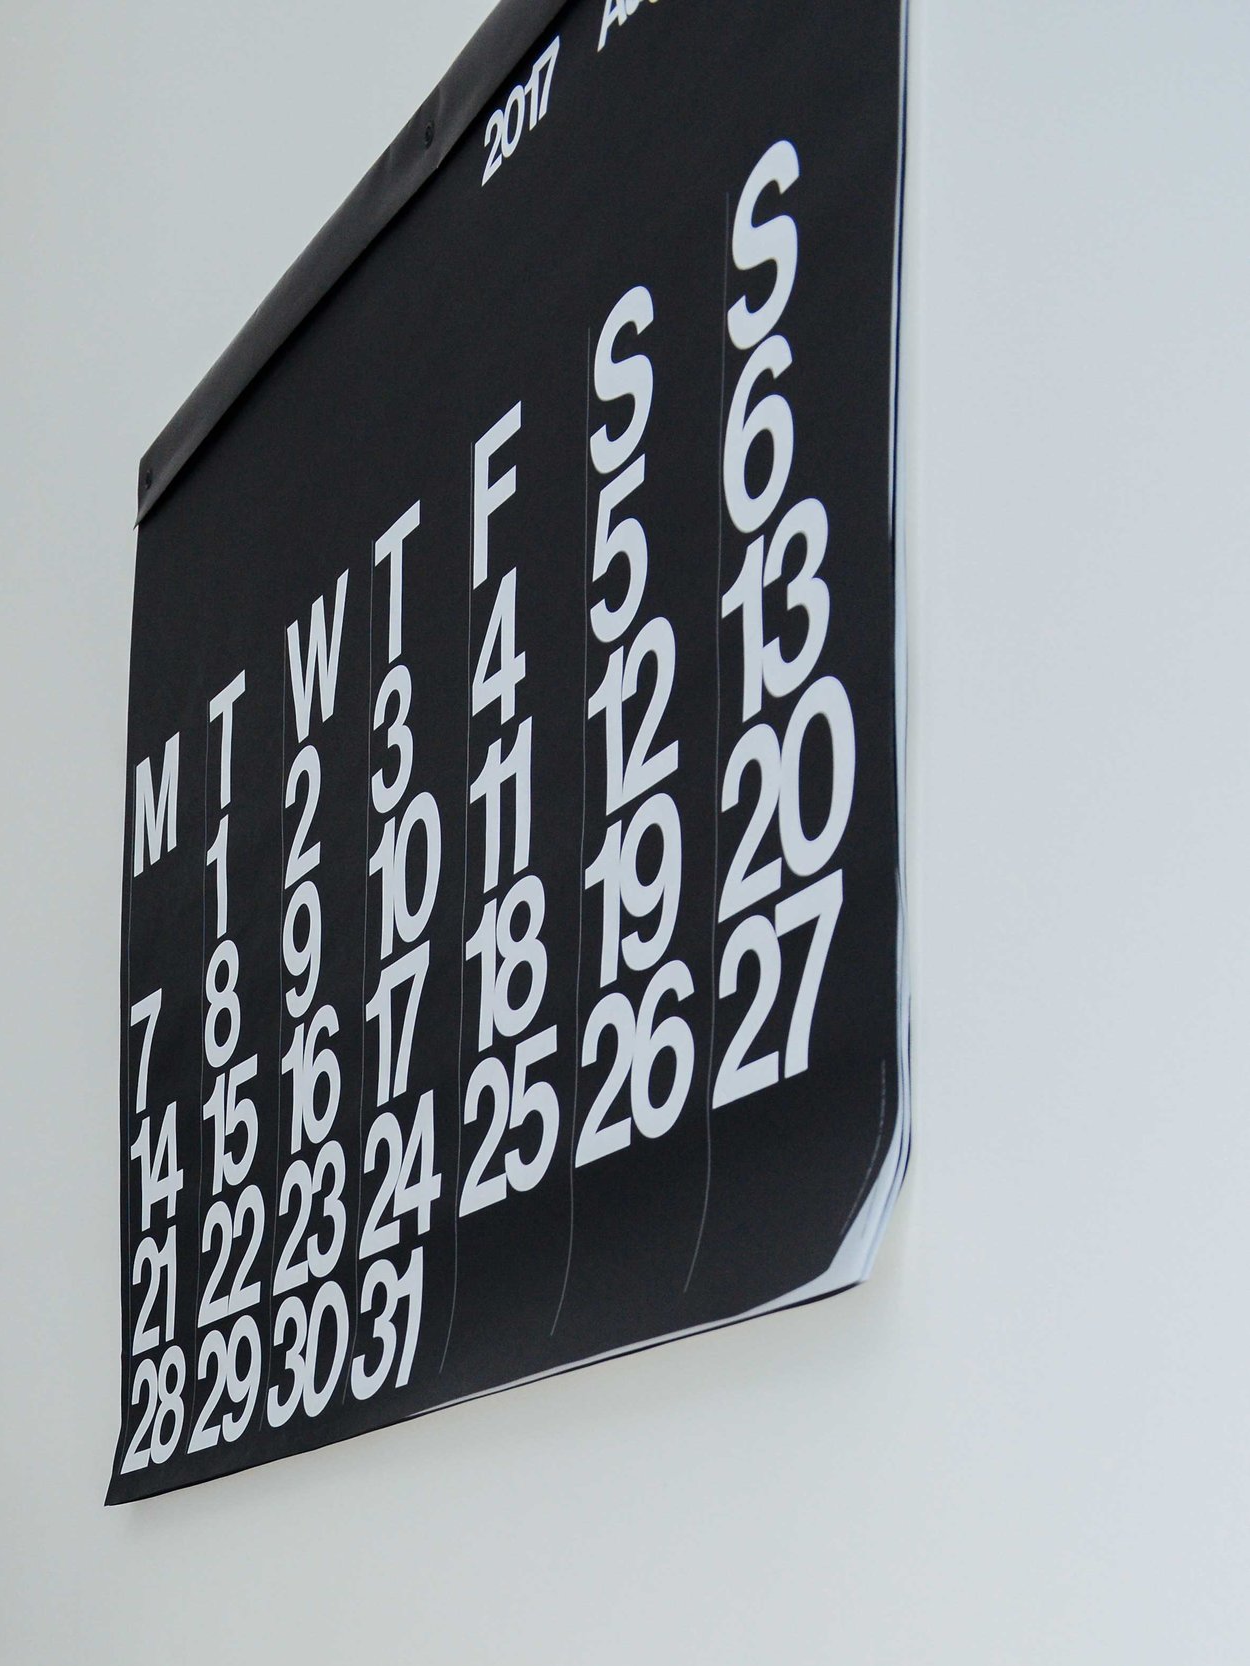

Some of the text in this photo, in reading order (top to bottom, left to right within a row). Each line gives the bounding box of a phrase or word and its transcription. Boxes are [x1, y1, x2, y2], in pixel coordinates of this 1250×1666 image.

[481, 35, 560, 187] 2017
[135, 140, 800, 877] M T W T F S S
[206, 334, 794, 939] 1 2 3 4 5 6
[130, 497, 831, 1114] 7 8 9 10 11 12 13
[130, 675, 856, 1232] 14 15 16 17 18 19 20
[120, 1245, 424, 1475] 28 29 30 31
[132, 868, 844, 1357] 21 22 23 24 25 26 27
